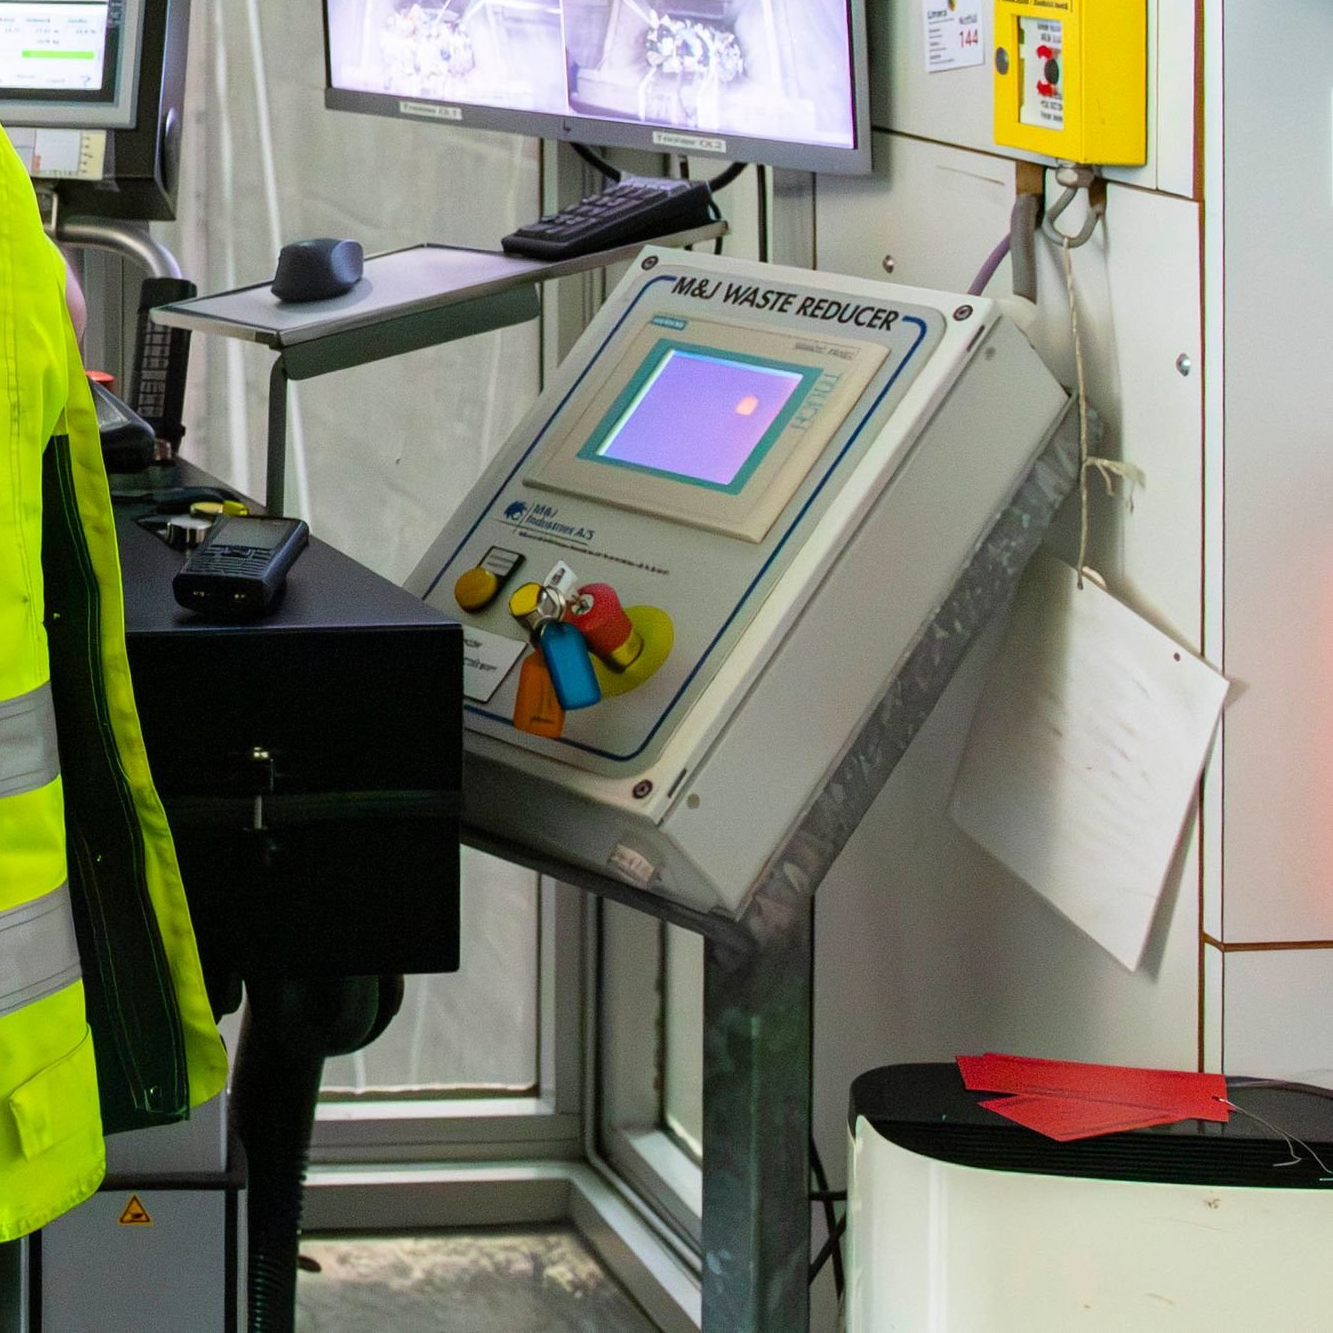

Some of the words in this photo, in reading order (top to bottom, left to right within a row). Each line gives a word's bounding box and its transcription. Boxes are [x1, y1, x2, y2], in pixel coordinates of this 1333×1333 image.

[959, 29, 979, 48] 144
[671, 276, 723, 300] M&J
[722, 282, 798, 314] WASTE
[795, 296, 900, 331] REDUCER
